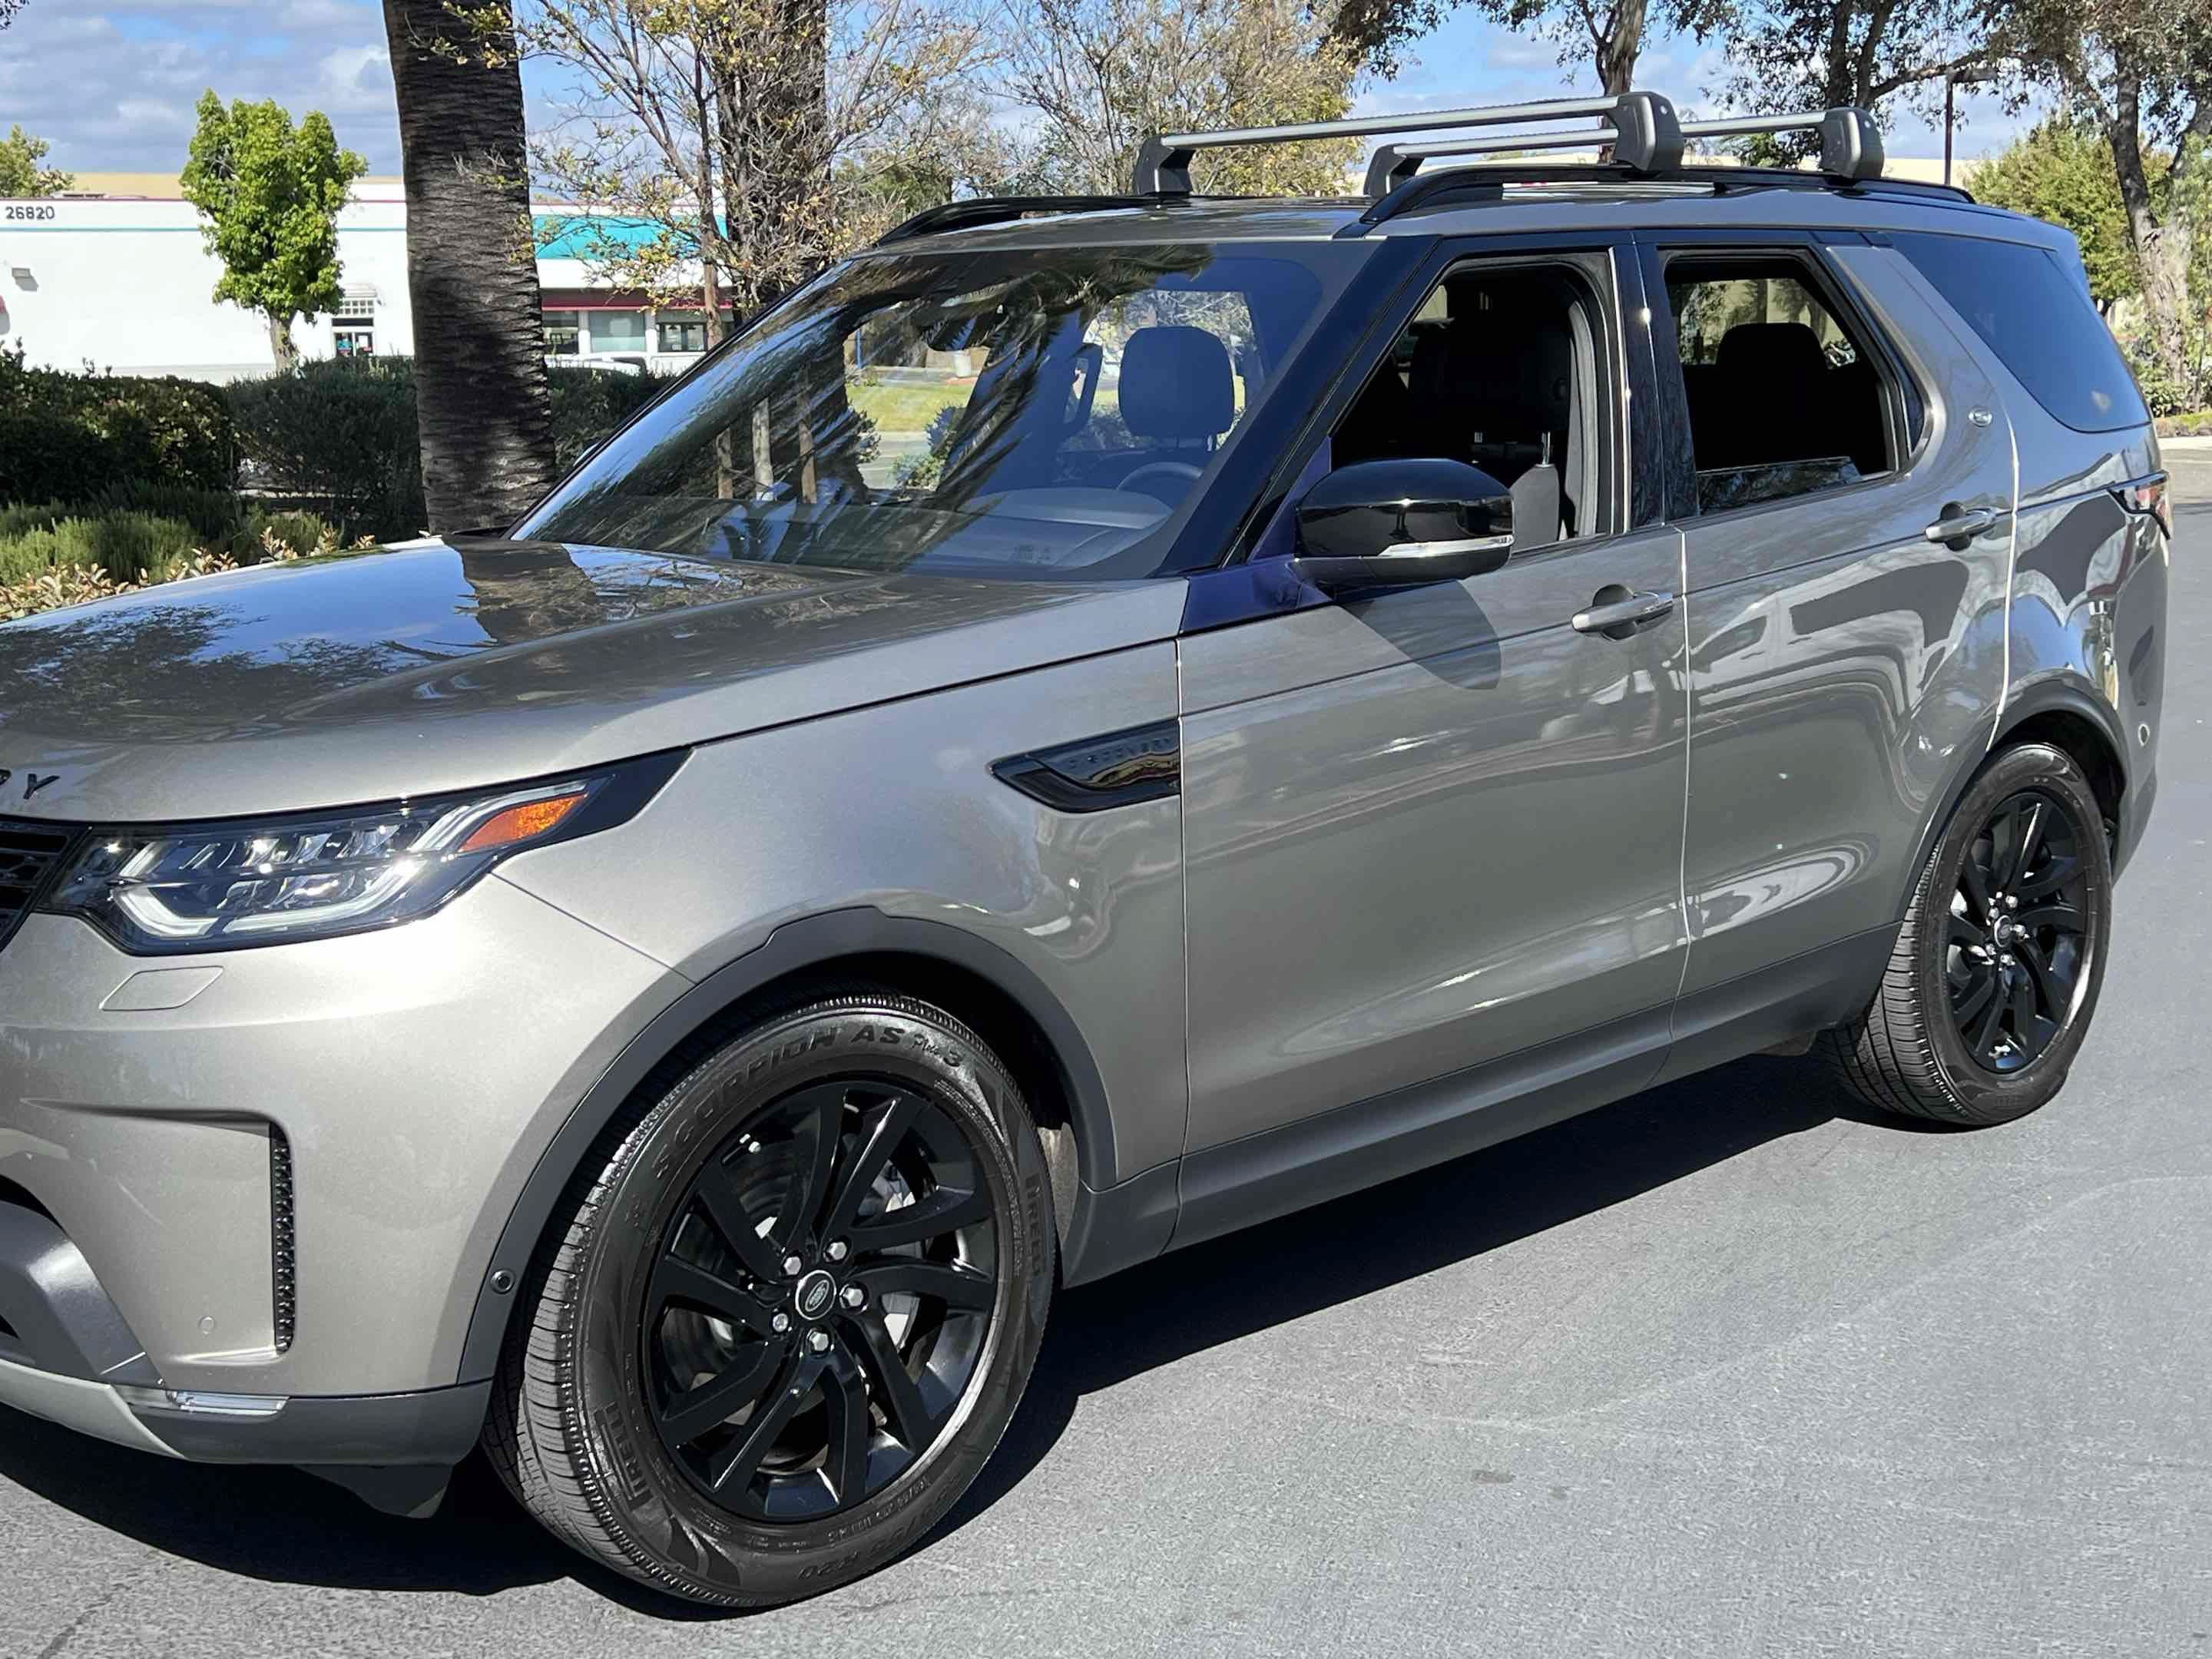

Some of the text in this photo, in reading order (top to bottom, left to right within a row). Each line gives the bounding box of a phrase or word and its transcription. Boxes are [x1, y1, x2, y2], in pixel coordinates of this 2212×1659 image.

[5, 205, 55, 220] 26820
[650, 1027, 843, 1180] SCORPION
[850, 1025, 905, 1045] AS
[943, 1050, 962, 1067] 3
